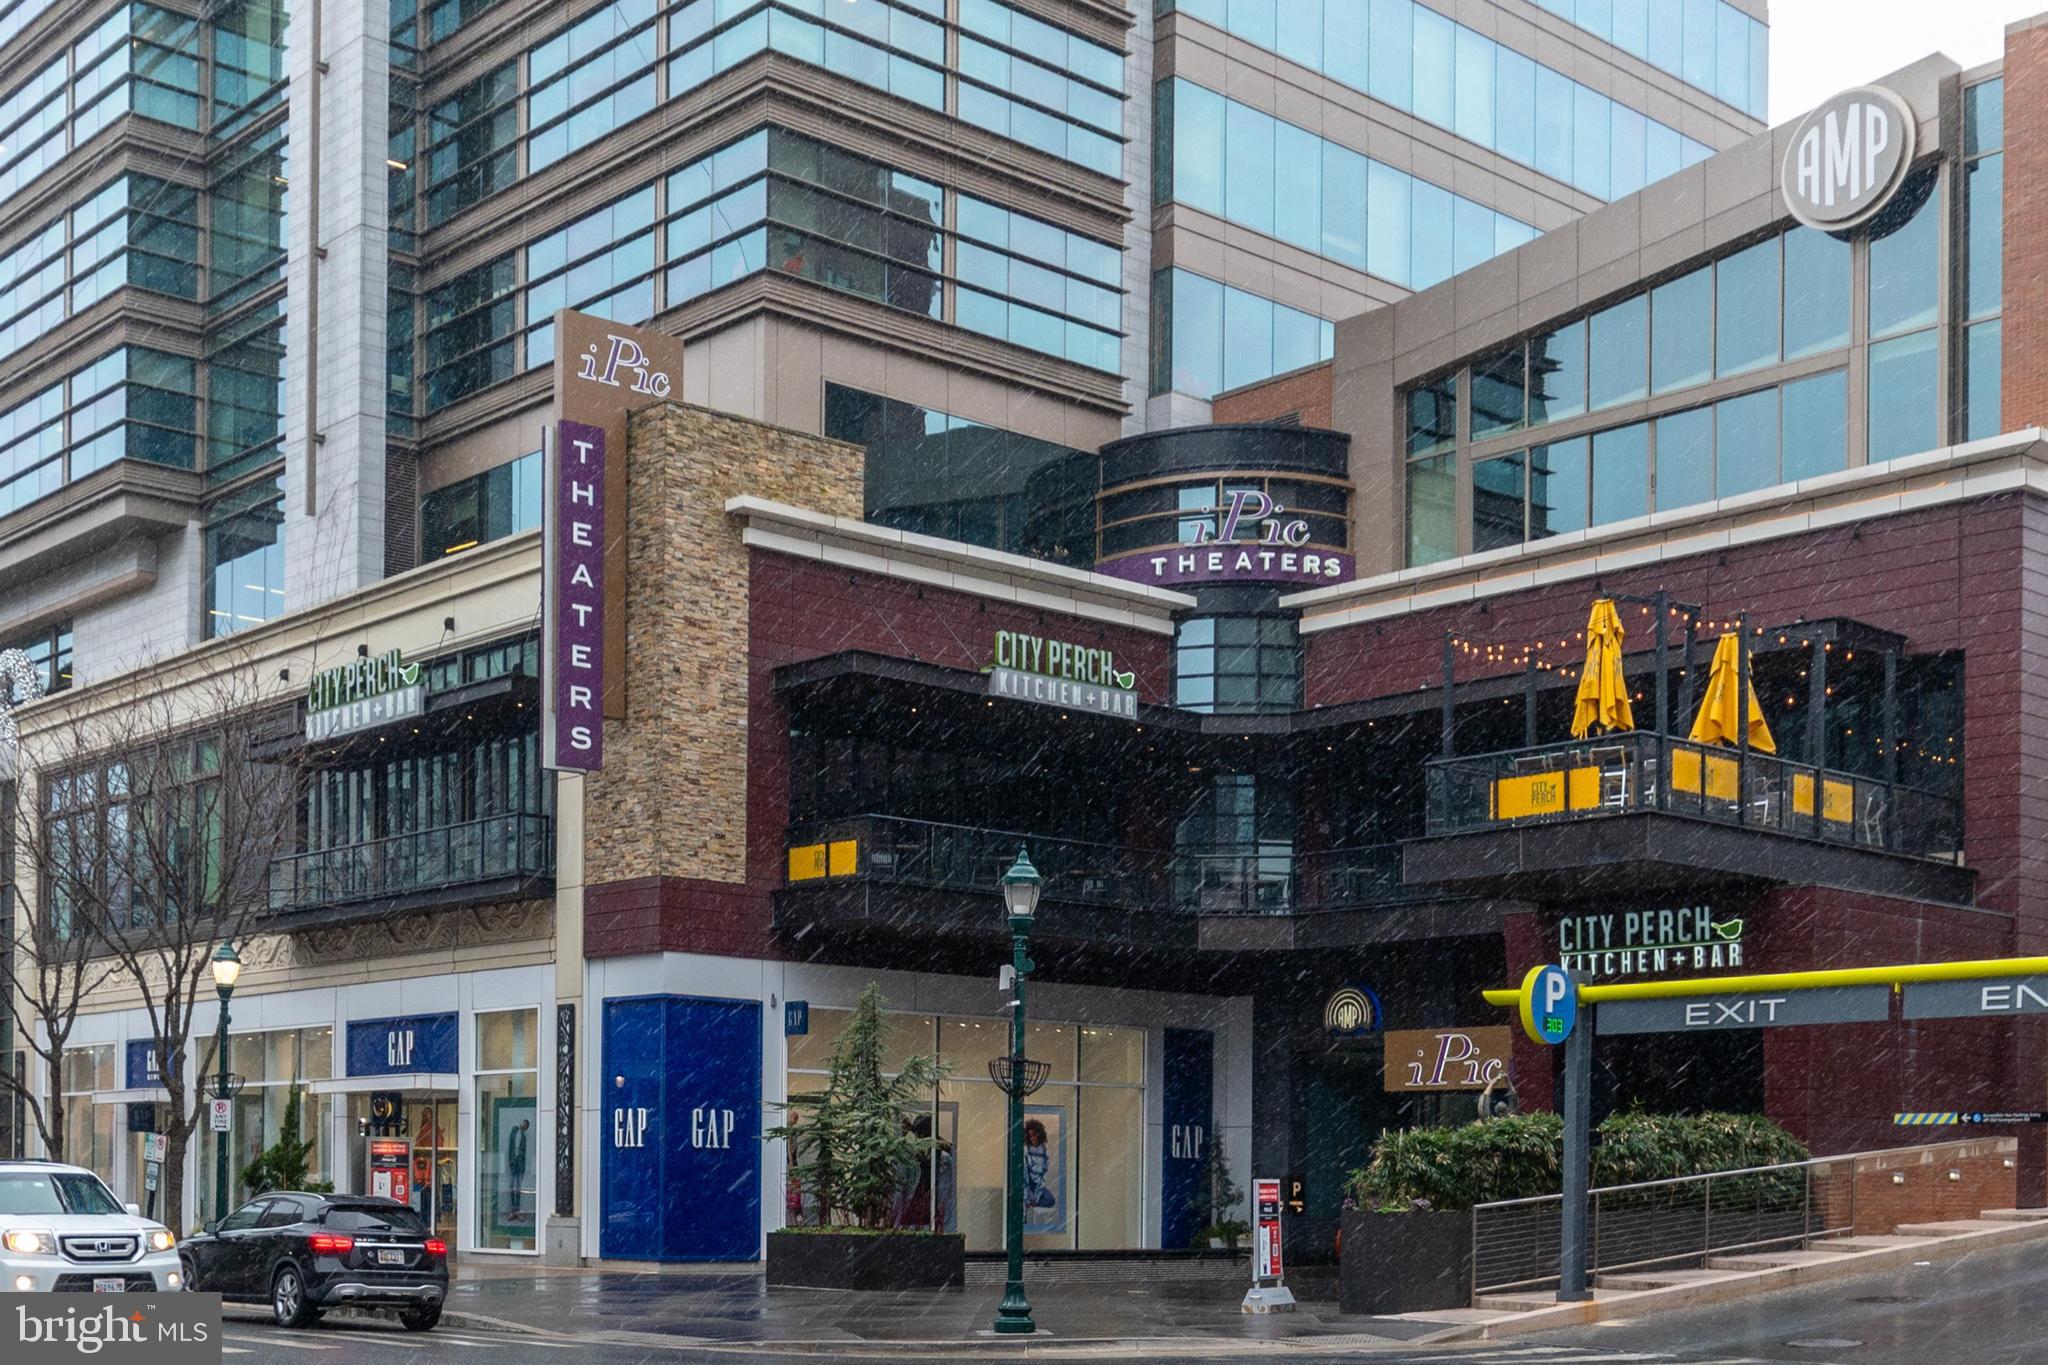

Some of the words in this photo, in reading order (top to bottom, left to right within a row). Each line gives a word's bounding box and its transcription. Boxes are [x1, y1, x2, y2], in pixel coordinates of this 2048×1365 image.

[1798, 103, 1888, 206] AMP
[578, 334, 671, 397] iPic
[1184, 490, 1311, 547] iPic
[1151, 552, 1341, 577] THEATERS
[570, 439, 594, 750] THEATERS
[995, 630, 1043, 673] CITY
[1046, 639, 1113, 686] PERCH
[308, 666, 342, 713] CITY
[345, 648, 401, 703] PERCH
[1531, 780, 1548, 793] CITY
[1531, 789, 1556, 805] PERCH
[1560, 914, 1613, 951] CITY
[1625, 906, 1710, 946] PERCH
[1546, 972, 1566, 1013] P
[788, 1011, 802, 1027] GAP
[1338, 1005, 1358, 1029] AMP
[1547, 1018, 1563, 1033] 303
[1686, 998, 1787, 1026] EXIT
[146, 1049, 160, 1072] GA
[388, 1031, 413, 1067] GAP
[1405, 1033, 1502, 1086] iPic
[614, 1107, 648, 1148] GAP
[692, 1108, 735, 1149] GAP
[1172, 1125, 1203, 1159] GAP
[1293, 1182, 1302, 1197] P
